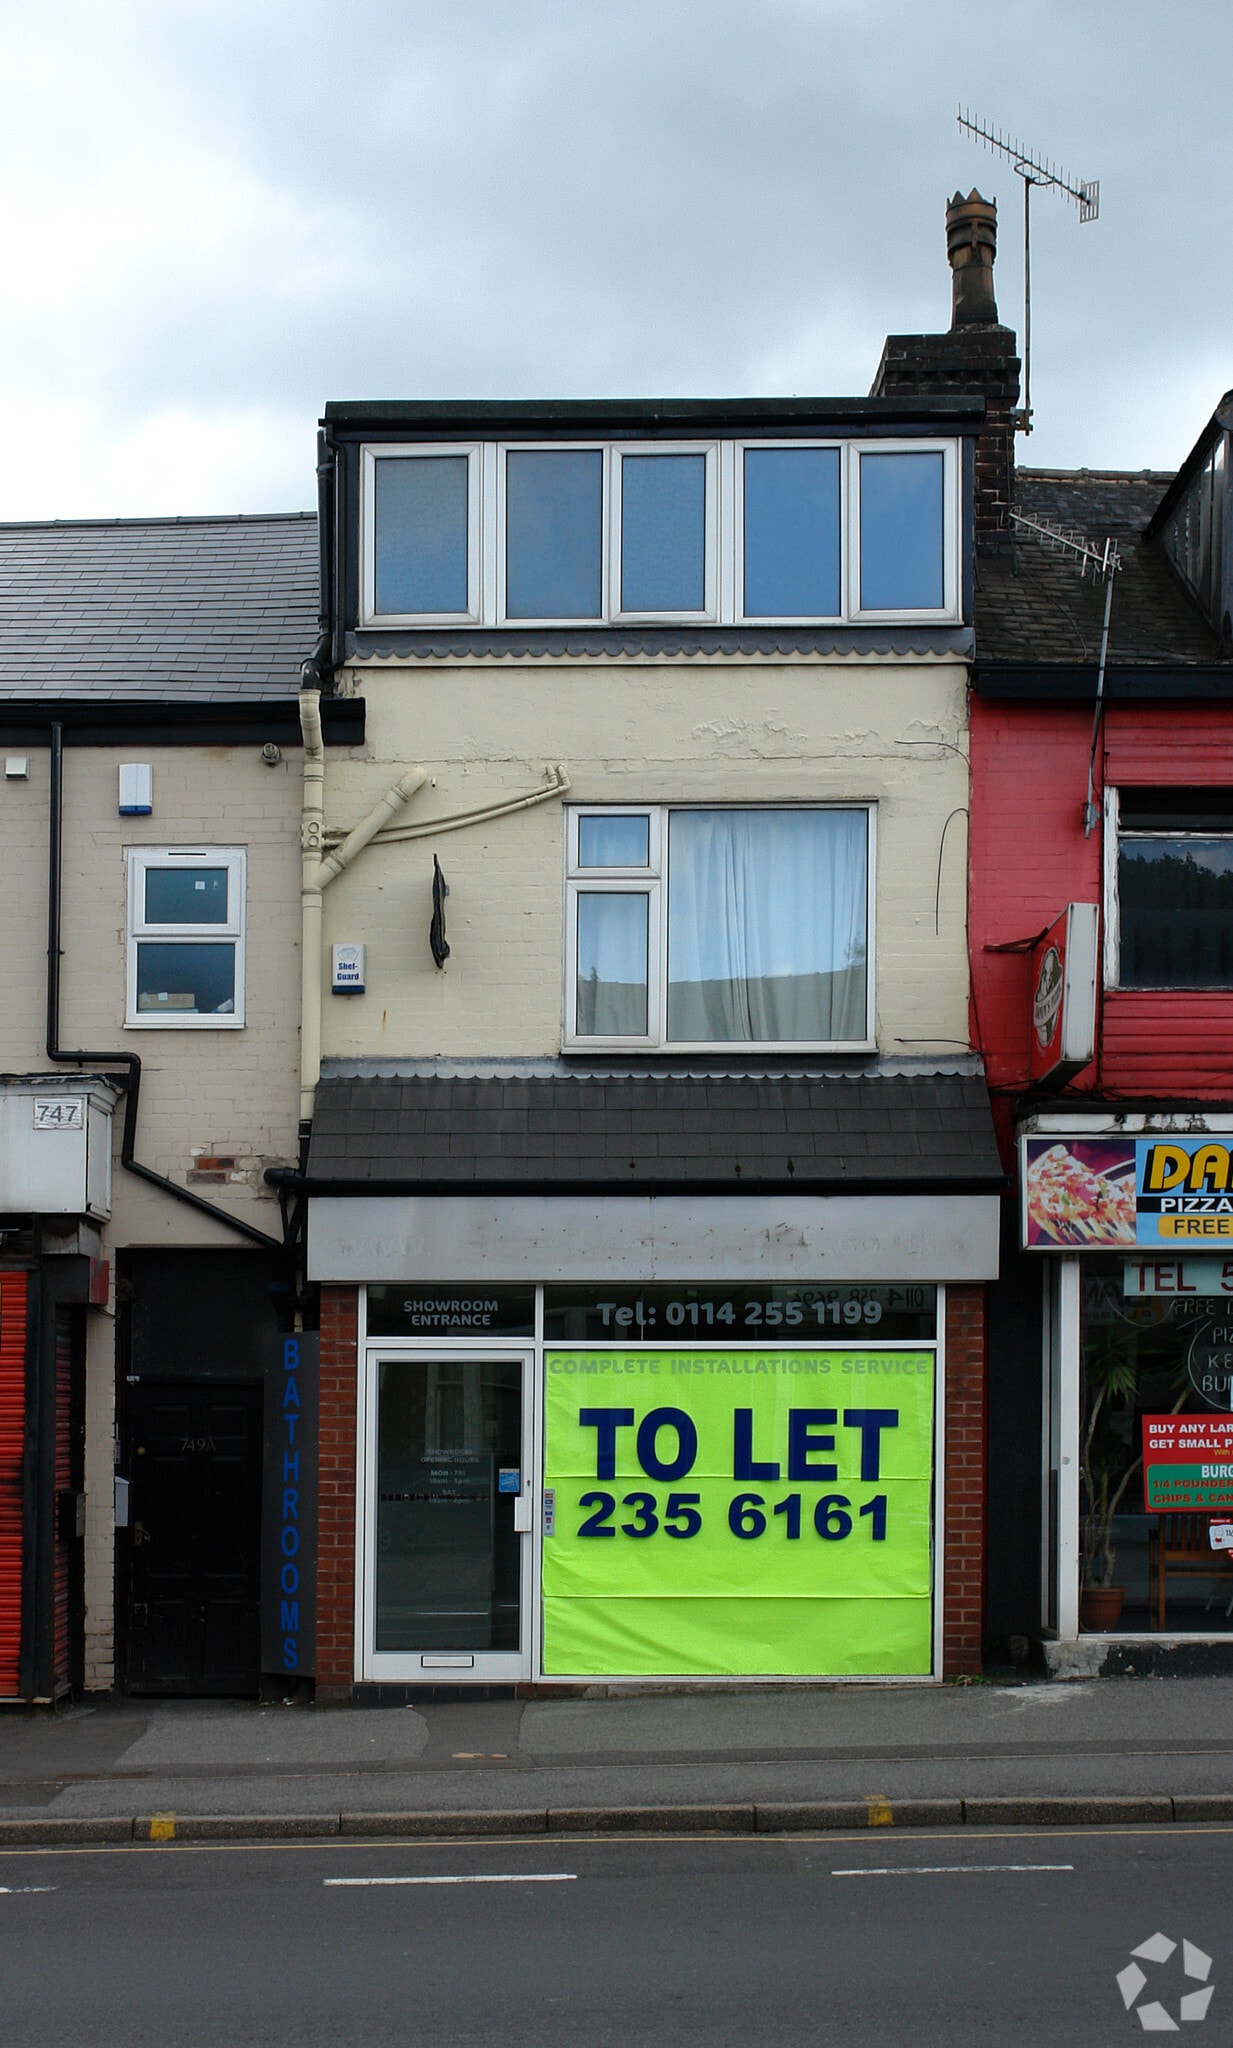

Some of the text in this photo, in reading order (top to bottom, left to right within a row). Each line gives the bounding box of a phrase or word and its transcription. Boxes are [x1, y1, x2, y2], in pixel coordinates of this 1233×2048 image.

[37, 1105, 78, 1122] 747
[1143, 1144, 1233, 1193] DA
[1160, 1197, 1233, 1213] PIZZA
[1174, 1219, 1230, 1234] FREE
[1131, 1262, 1196, 1291] TEL
[403, 1300, 498, 1312] SHOWROOM
[597, 1301, 882, 1325] Tel: 0114 255 1199
[411, 1314, 491, 1326] ENTRANCE
[549, 1358, 927, 1375] COMPLETE INSTALLATIONS SERVICE
[1202, 1374, 1231, 1392] BU
[1149, 1424, 1175, 1434] BUY
[1179, 1423, 1206, 1433] ANY
[180, 1438, 216, 1452] 749A
[579, 1407, 899, 1481] TO LET
[1149, 1439, 1175, 1449] GET
[1178, 1439, 1221, 1448] SMALL
[1153, 1480, 1171, 1488] 1/4
[280, 1339, 300, 1670] BATHROOMS
[1153, 1494, 1191, 1503] CHIPS
[1195, 1494, 1204, 1502] &
[577, 1492, 702, 1538] 235
[728, 1493, 887, 1540] 6161
